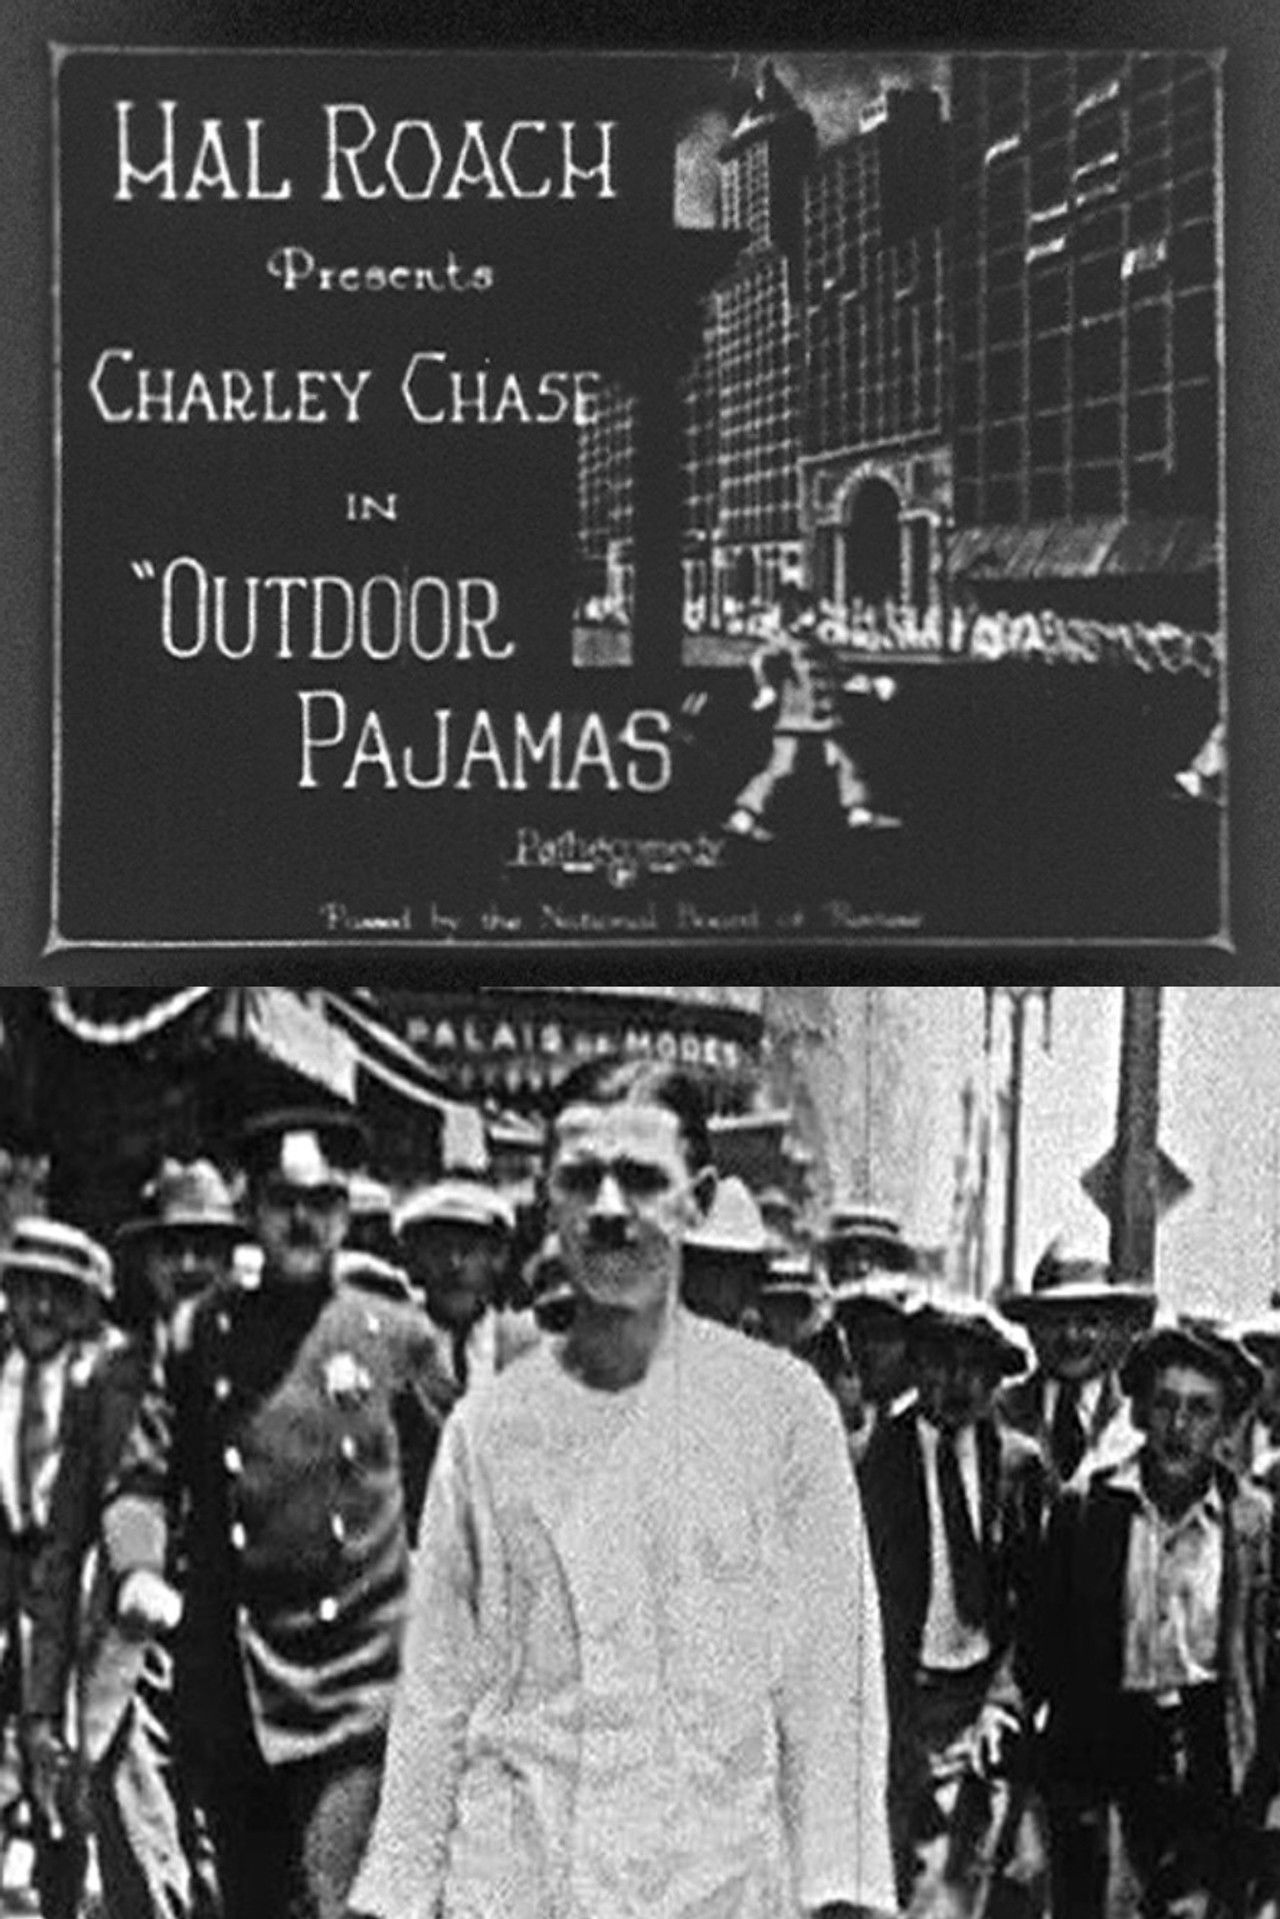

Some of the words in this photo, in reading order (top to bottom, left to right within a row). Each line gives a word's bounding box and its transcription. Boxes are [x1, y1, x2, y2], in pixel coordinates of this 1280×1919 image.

[113, 100, 292, 202] HAL
[320, 103, 617, 201] ROACH
[266, 245, 496, 291] Presents
[89, 348, 372, 425] CHARLEY
[401, 351, 604, 426] CHASE
[346, 492, 399, 521] IN
[131, 555, 516, 661] "OUTDOOR
[298, 690, 708, 793] PAJAMAS"
[406, 1016, 562, 1054] PALAIS
